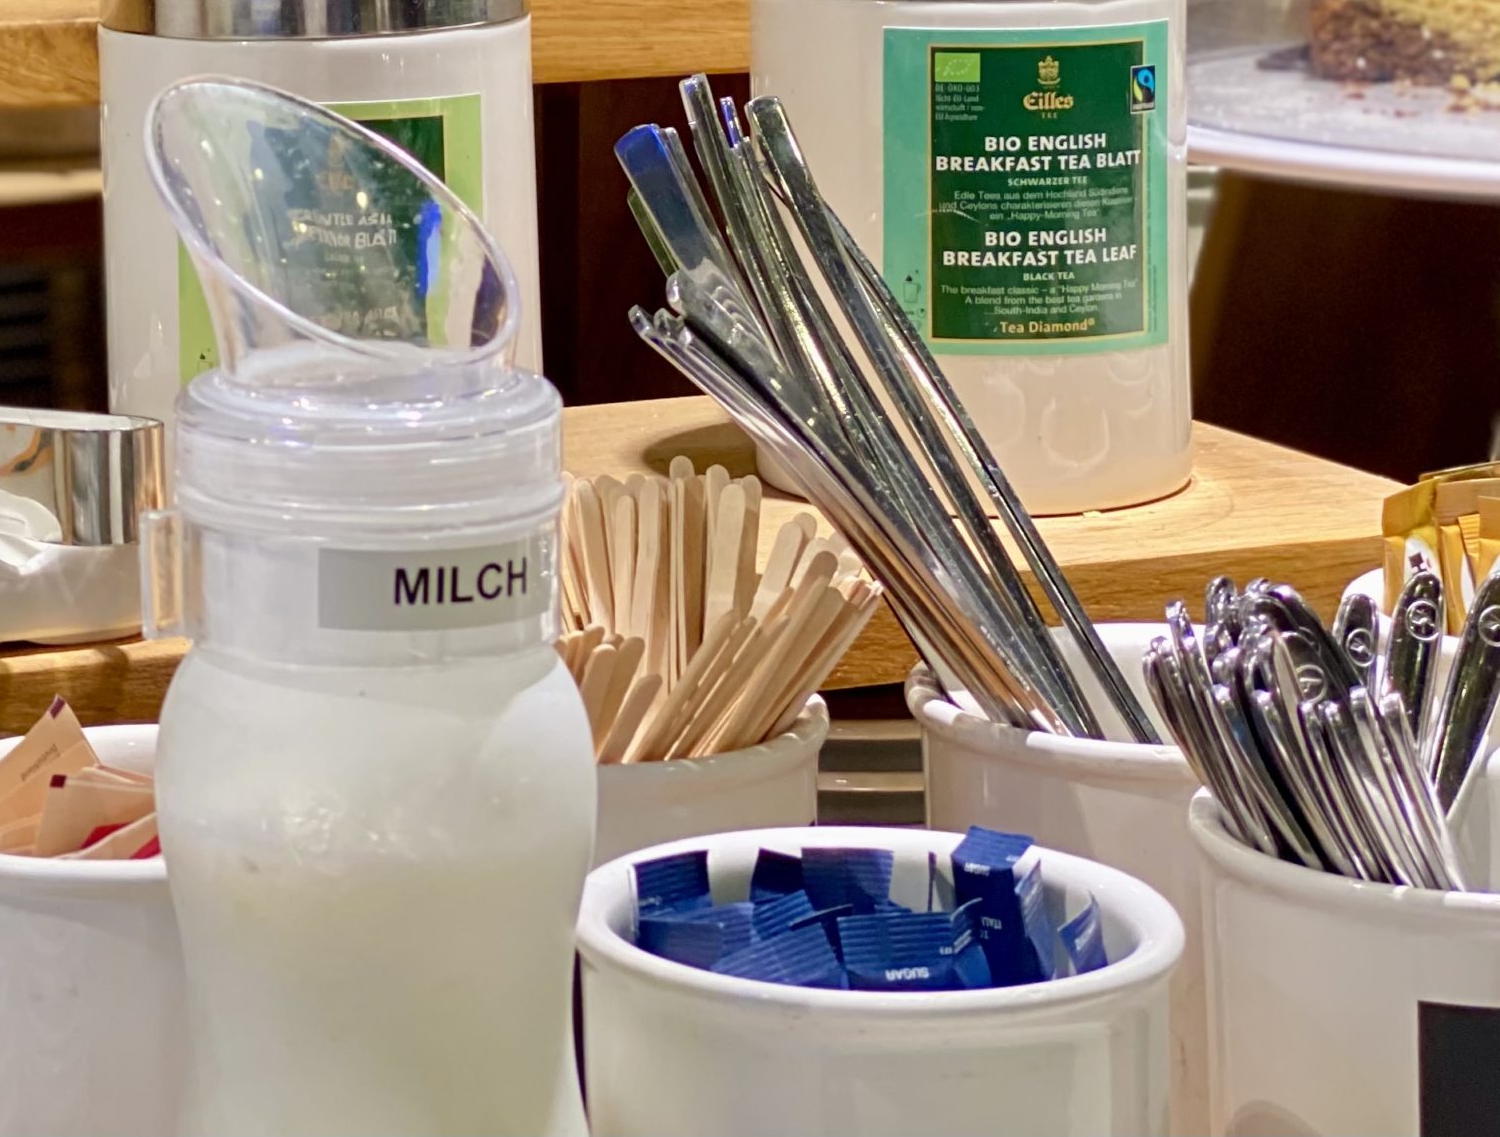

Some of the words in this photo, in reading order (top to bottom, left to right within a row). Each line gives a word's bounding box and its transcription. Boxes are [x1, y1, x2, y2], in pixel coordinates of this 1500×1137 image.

[1023, 91, 1075, 111] Eilles
[985, 136, 1021, 152] BIO
[1028, 133, 1107, 152] ENGLISH
[935, 155, 1052, 172] BREAKFAST
[1058, 154, 1091, 170] TEA
[1096, 150, 1141, 169] BLATT
[1007, 176, 1071, 187] SCHWARZER
[1072, 175, 1088, 186] TEE
[985, 231, 1022, 246] BIO
[1028, 227, 1107, 246] ENGLISH
[943, 250, 1059, 267] BREAKFAST
[1064, 249, 1097, 264] TEA
[1102, 244, 1138, 262] LEAF
[1023, 272, 1055, 282] BLACK
[1057, 271, 1075, 281] TEA
[1000, 321, 1025, 334] Tea
[393, 556, 528, 606] MILCH
[884, 966, 930, 981] SUGAR
